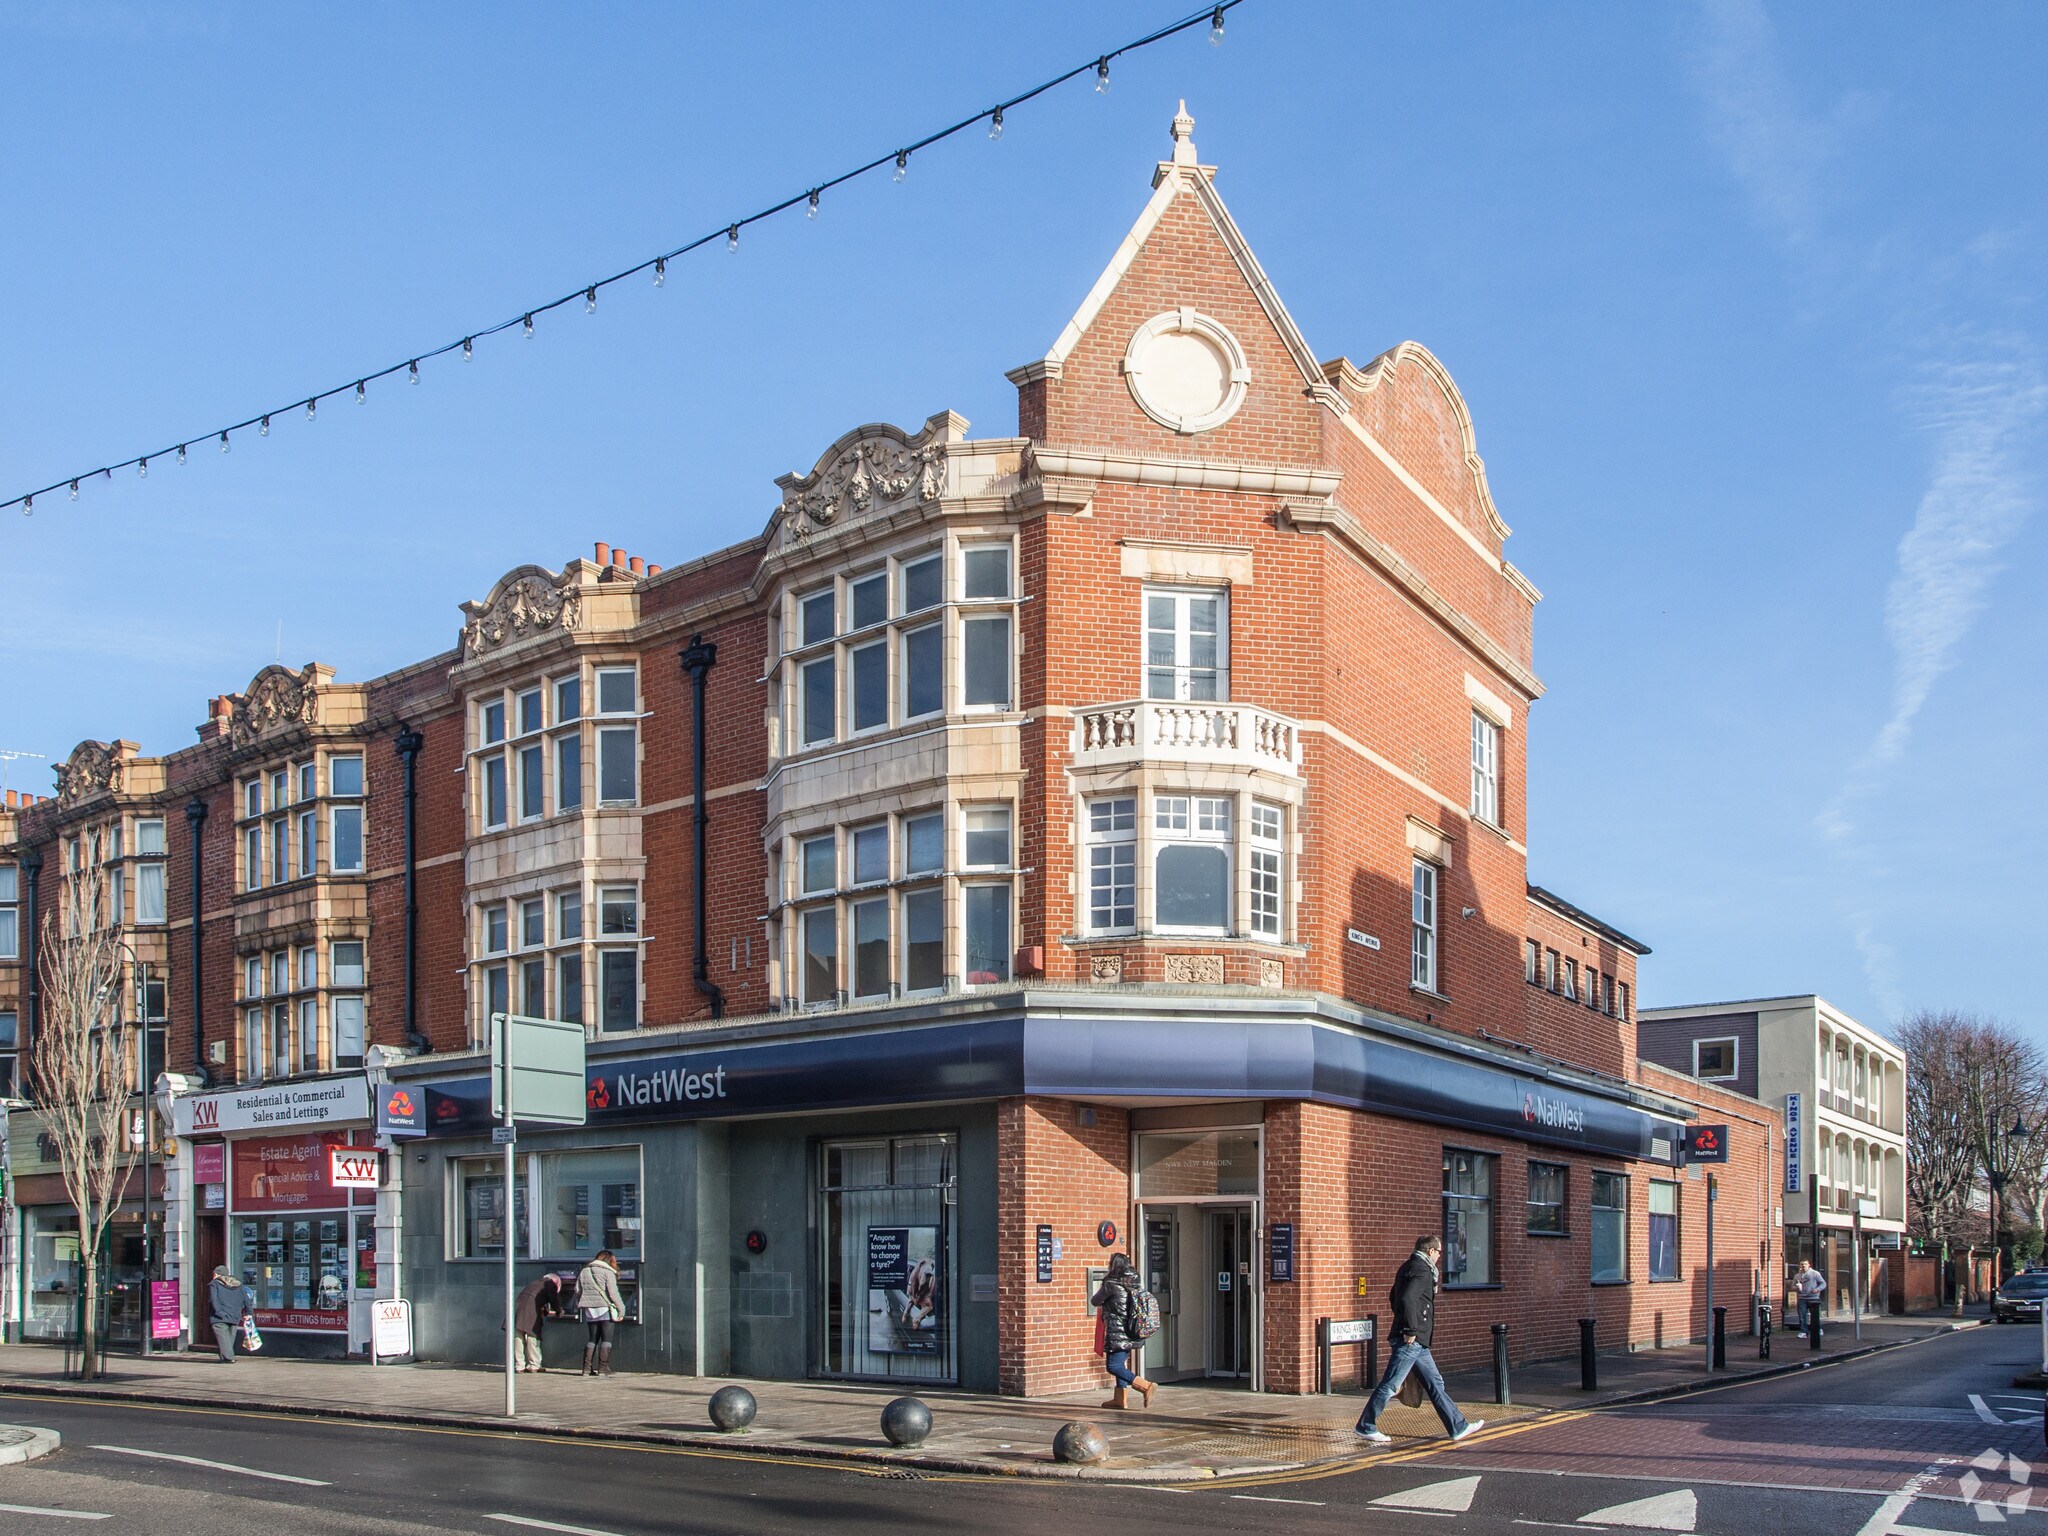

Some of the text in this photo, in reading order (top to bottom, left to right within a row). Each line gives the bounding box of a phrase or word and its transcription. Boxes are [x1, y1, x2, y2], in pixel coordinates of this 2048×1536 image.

[618, 1064, 726, 1106] NatWest
[237, 1086, 345, 1109] Residential & Commercial
[192, 1100, 218, 1124] KW
[253, 1106, 329, 1122] Sales and Lettings
[1537, 1096, 1583, 1132] NatWest
[388, 1117, 415, 1125] NatWest
[1789, 1096, 1798, 1190] KINGS AVENUE HOUSE
[261, 1144, 320, 1161] Estate Agent
[336, 1155, 375, 1177] KW
[261, 1170, 320, 1183] Financial Advice &
[273, 1193, 308, 1204] Mortgages
[878, 1251, 900, 1261] change
[256, 1314, 347, 1325] from 1% LETTINGS from 5%
[1337, 1324, 1351, 1334] KINGS
[1353, 1322, 1371, 1333] AVENUE
